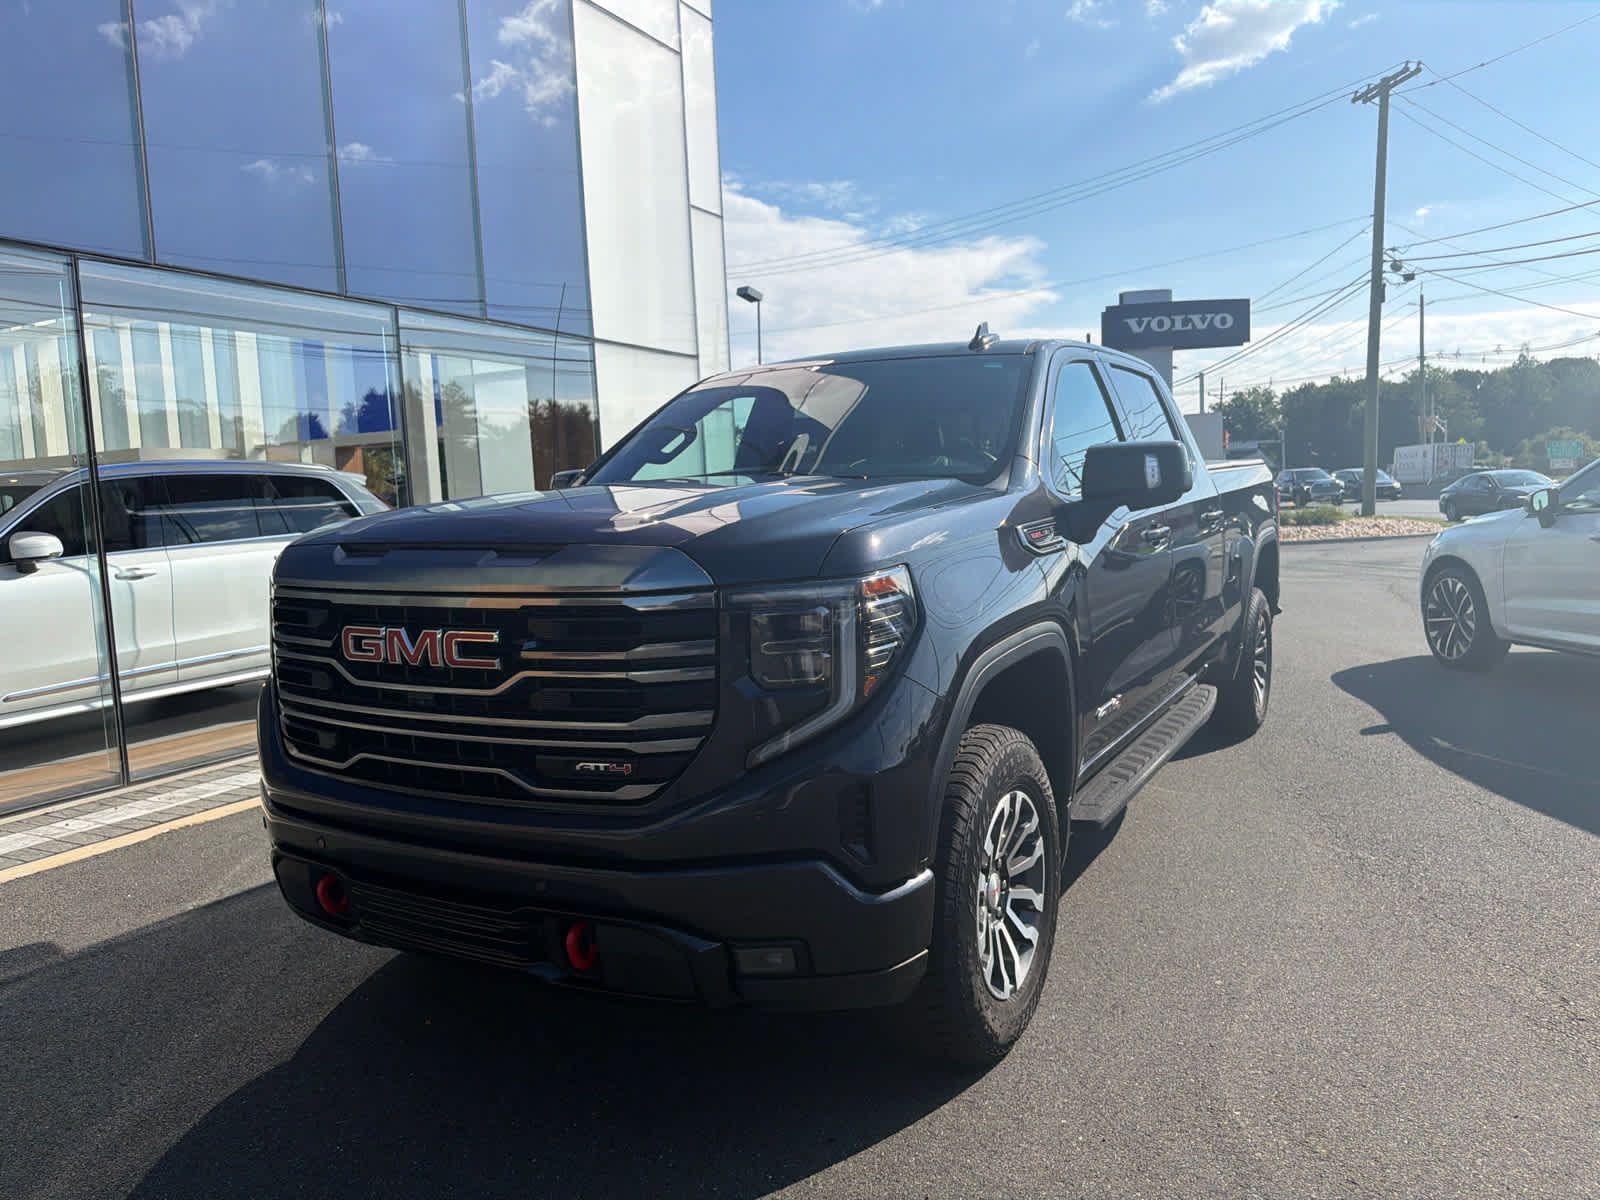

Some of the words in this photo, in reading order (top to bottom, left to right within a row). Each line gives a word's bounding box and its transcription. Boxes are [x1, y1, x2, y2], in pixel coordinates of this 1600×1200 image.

[1123, 312, 1235, 334] VOLVO
[341, 625, 501, 670] GMC
[575, 762, 632, 776] AT4
